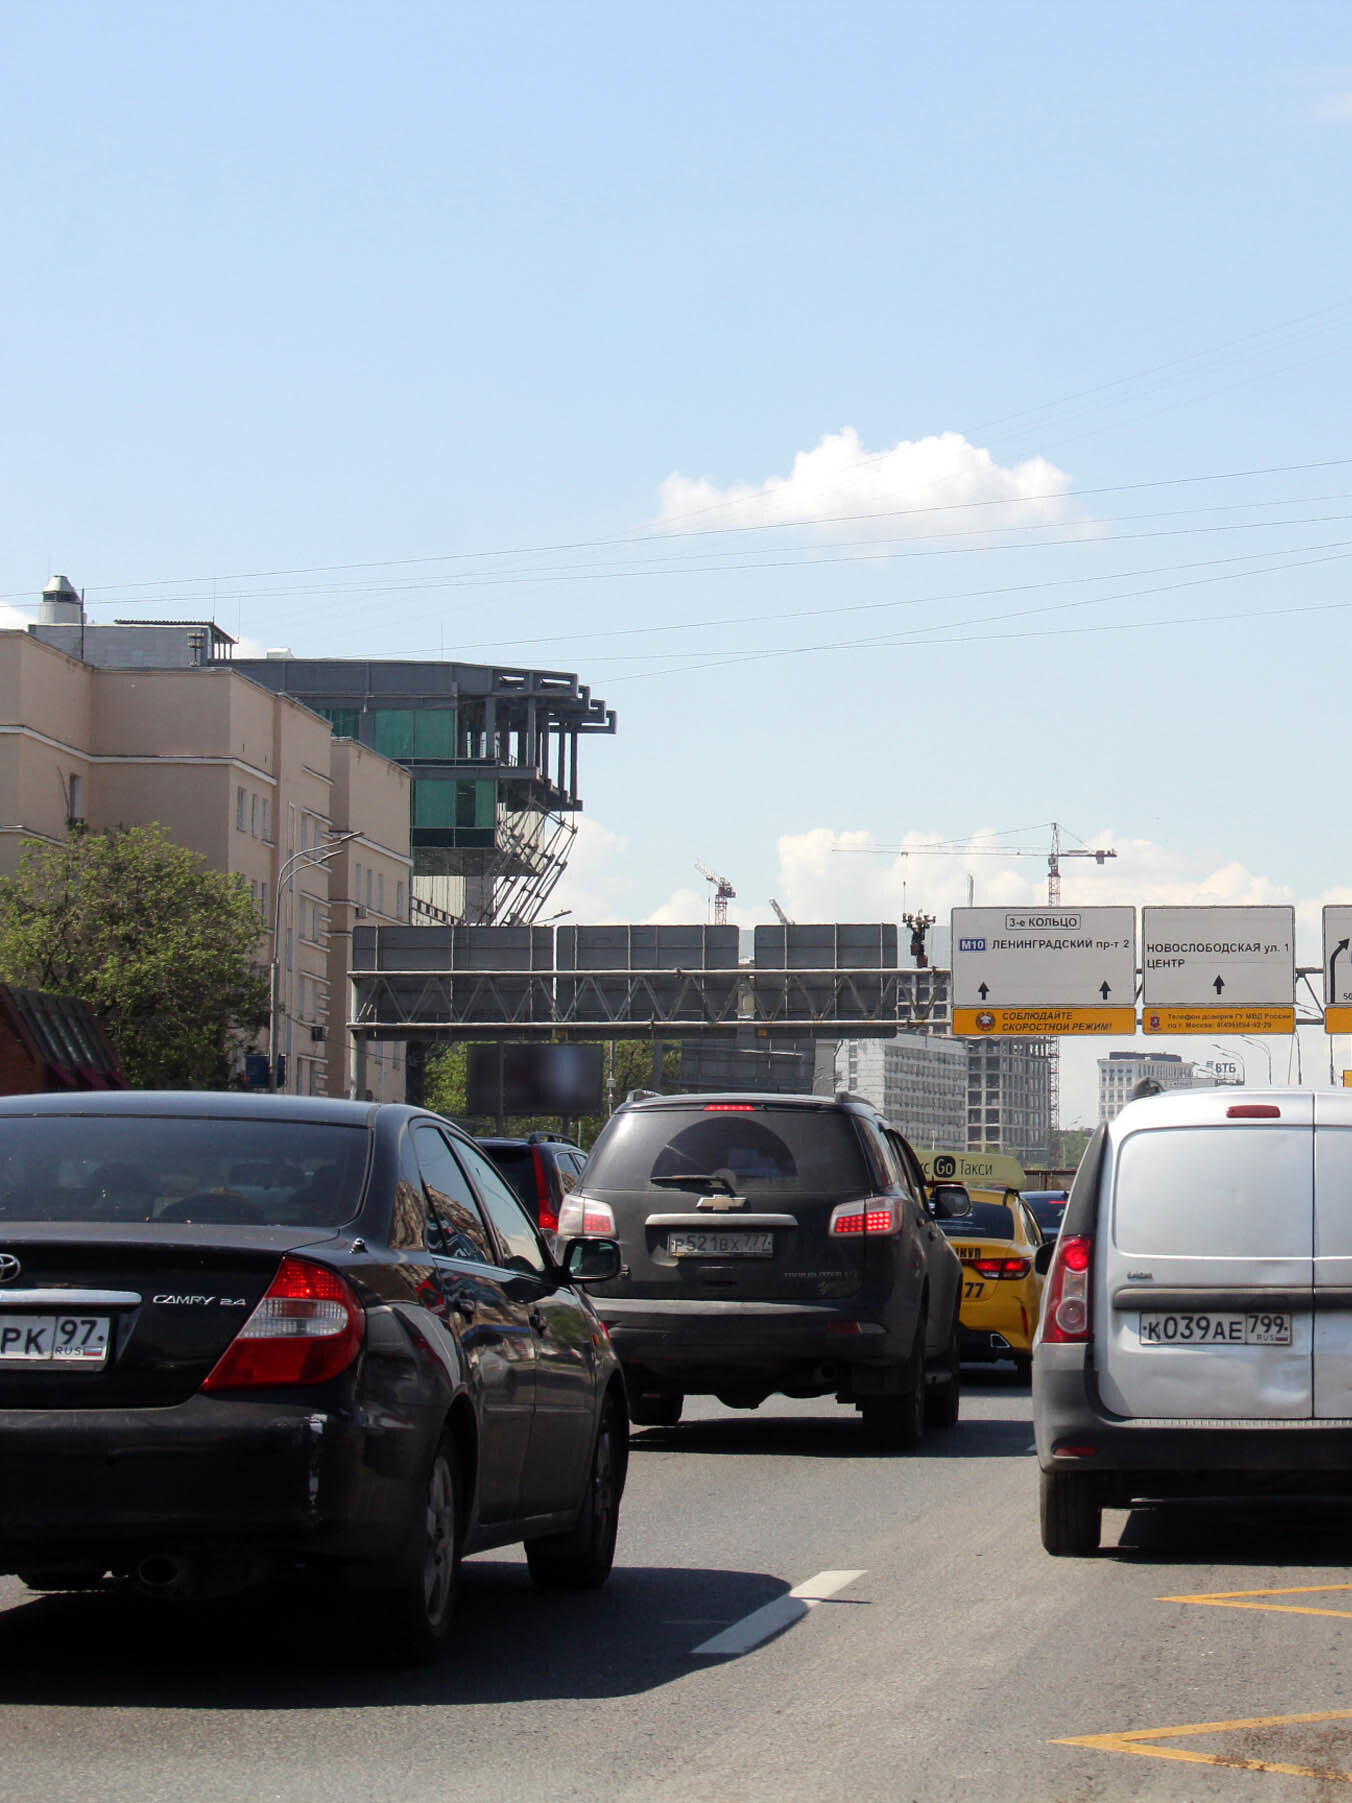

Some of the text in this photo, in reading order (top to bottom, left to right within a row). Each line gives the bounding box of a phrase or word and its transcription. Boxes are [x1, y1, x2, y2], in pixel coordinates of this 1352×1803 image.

[1009, 918, 1077, 928] 3-е КОЛЬЦО
[961, 938, 1129, 951] М10 ЛЕНИНГРАДСКИЙ пр-т 2
[1147, 943, 1289, 954] НОВОСЛОБОДСКАЯ ул. 1
[1147, 959, 1185, 970] ЦЕНТР
[1002, 1012, 1072, 1021] СОБЛЮДАЙТЕ
[1215, 1062, 1236, 1073] ВТБ
[936, 1159, 953, 1174] Go
[959, 1159, 993, 1175] Такси
[152, 1294, 215, 1305] CAMRY
[1249, 1315, 1283, 1334] 799
[60, 1319, 97, 1346] 97
[55, 1346, 82, 1355] RUS
